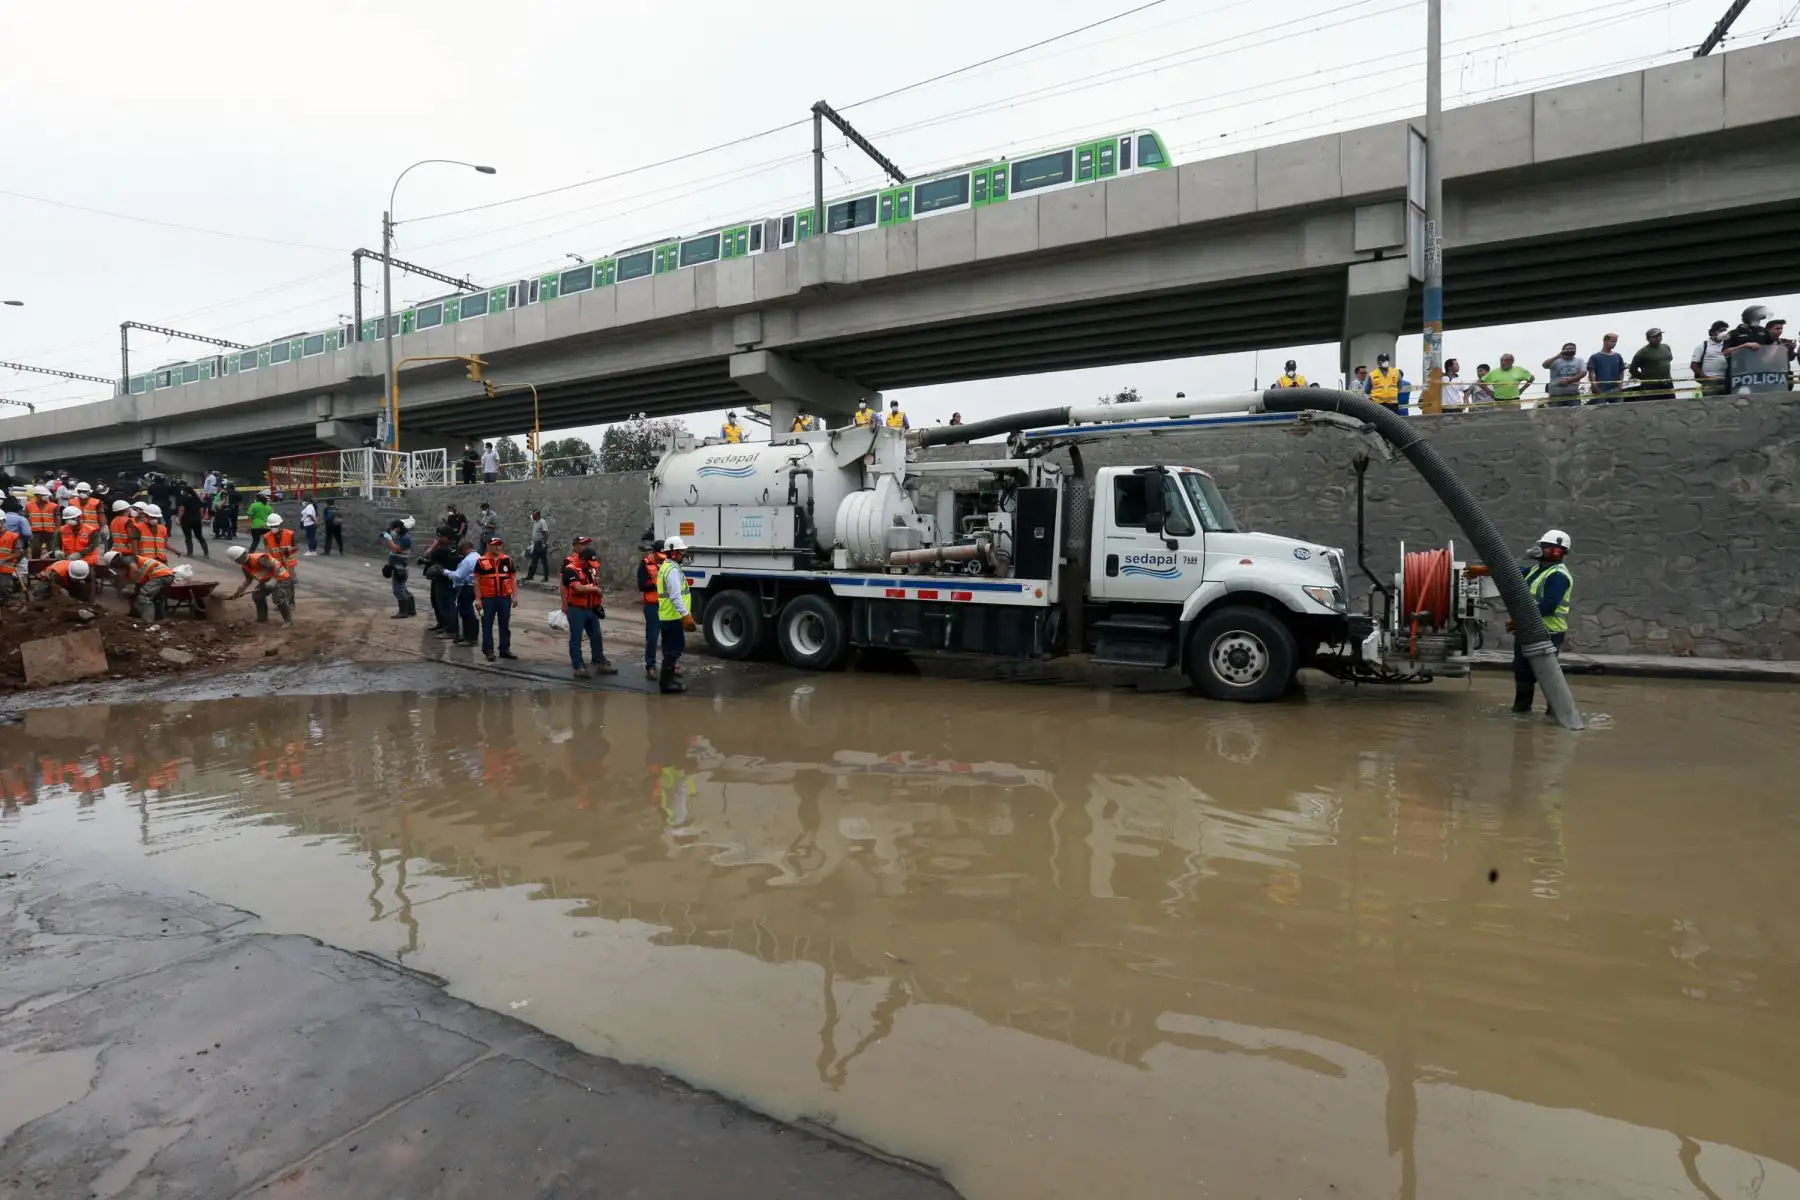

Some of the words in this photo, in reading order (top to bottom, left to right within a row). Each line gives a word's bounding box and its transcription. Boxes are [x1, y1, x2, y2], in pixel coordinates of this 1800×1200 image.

[1732, 373, 1787, 387] POLICIA
[705, 452, 760, 464] sedapal
[1125, 553, 1177, 566] sedapal
